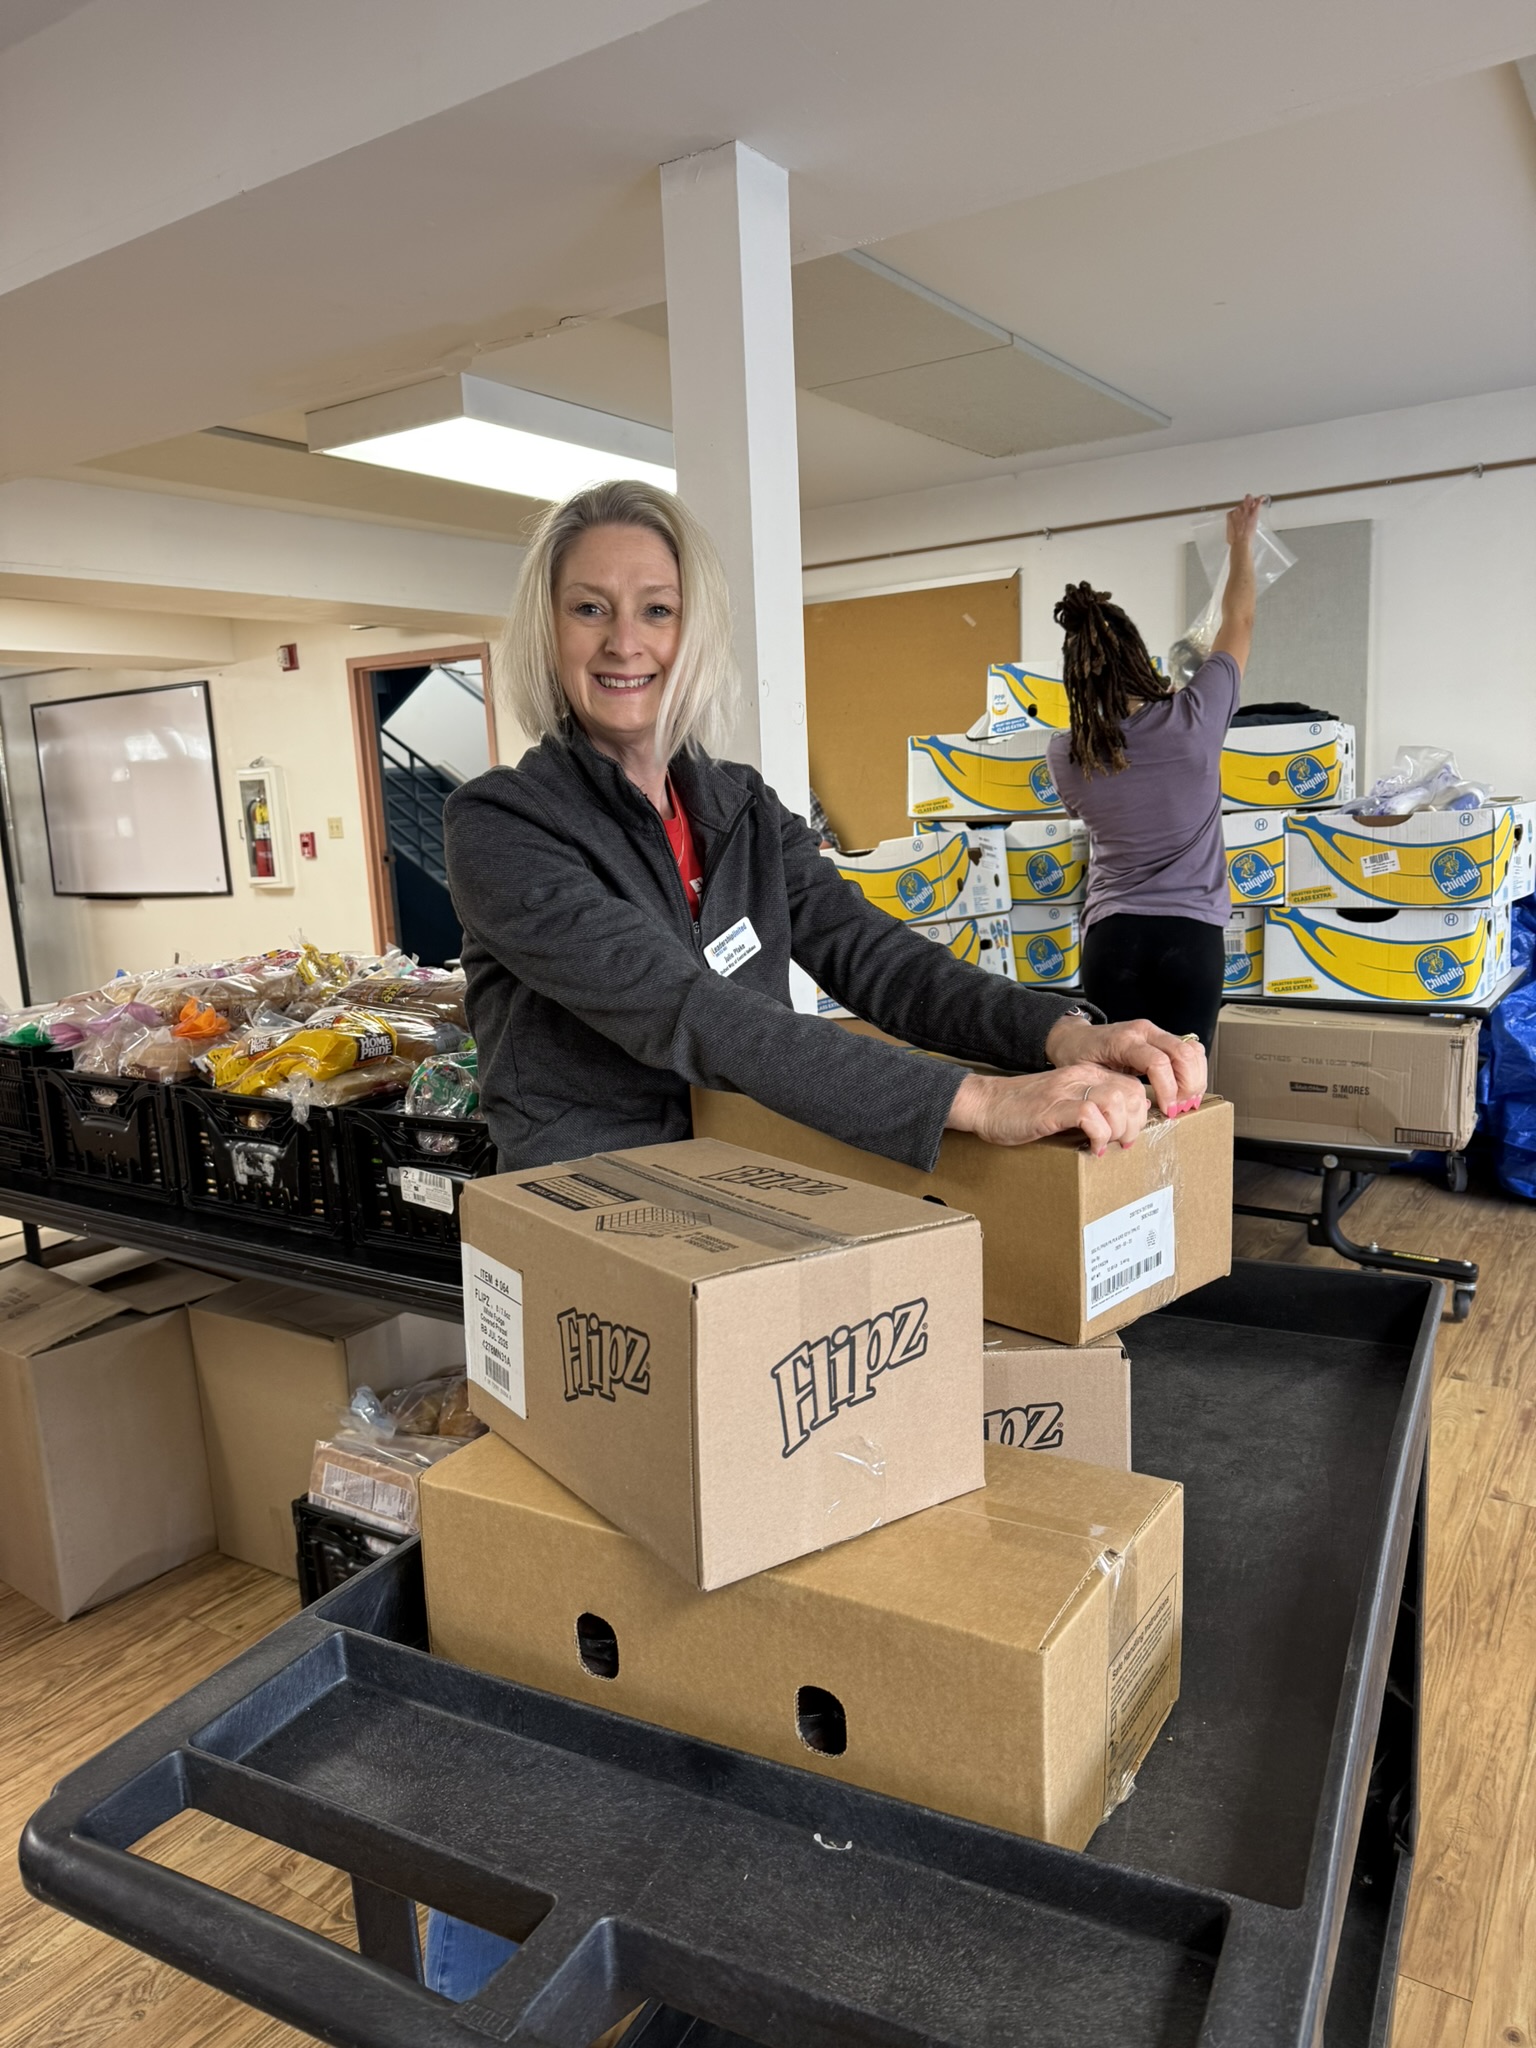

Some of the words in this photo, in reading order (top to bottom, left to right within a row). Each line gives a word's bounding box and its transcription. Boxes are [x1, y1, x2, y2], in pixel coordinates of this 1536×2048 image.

[996, 725, 1010, 733] CLASS
[1037, 784, 1058, 802] Chiq
[1294, 770, 1328, 796] Chiquita
[1033, 868, 1064, 891] Chiquita
[1237, 867, 1275, 894] Chiquita
[1440, 866, 1481, 894] Chiquita
[904, 884, 934, 912] Chiquita
[1034, 952, 1064, 975] Chiquita
[1222, 956, 1251, 978] hiquita
[1424, 966, 1465, 992] Chiquita
[250, 1043, 271, 1055] PRIDE
[359, 1036, 392, 1050] HOME
[360, 1044, 393, 1060] PRIDE
[1332, 1084, 1370, 1096] S'MORES
[698, 1166, 848, 1196] Flipz
[480, 1268, 494, 1284] ITEM
[480, 1312, 496, 1329] Covered
[493, 1312, 506, 1326] Fudge
[488, 1330, 498, 1342] JUL
[557, 1306, 650, 1402] Flipz
[770, 1297, 928, 1458] Flipz
[1122, 1633, 1144, 1669] Handling
[1144, 1594, 1170, 1635] Instructions
